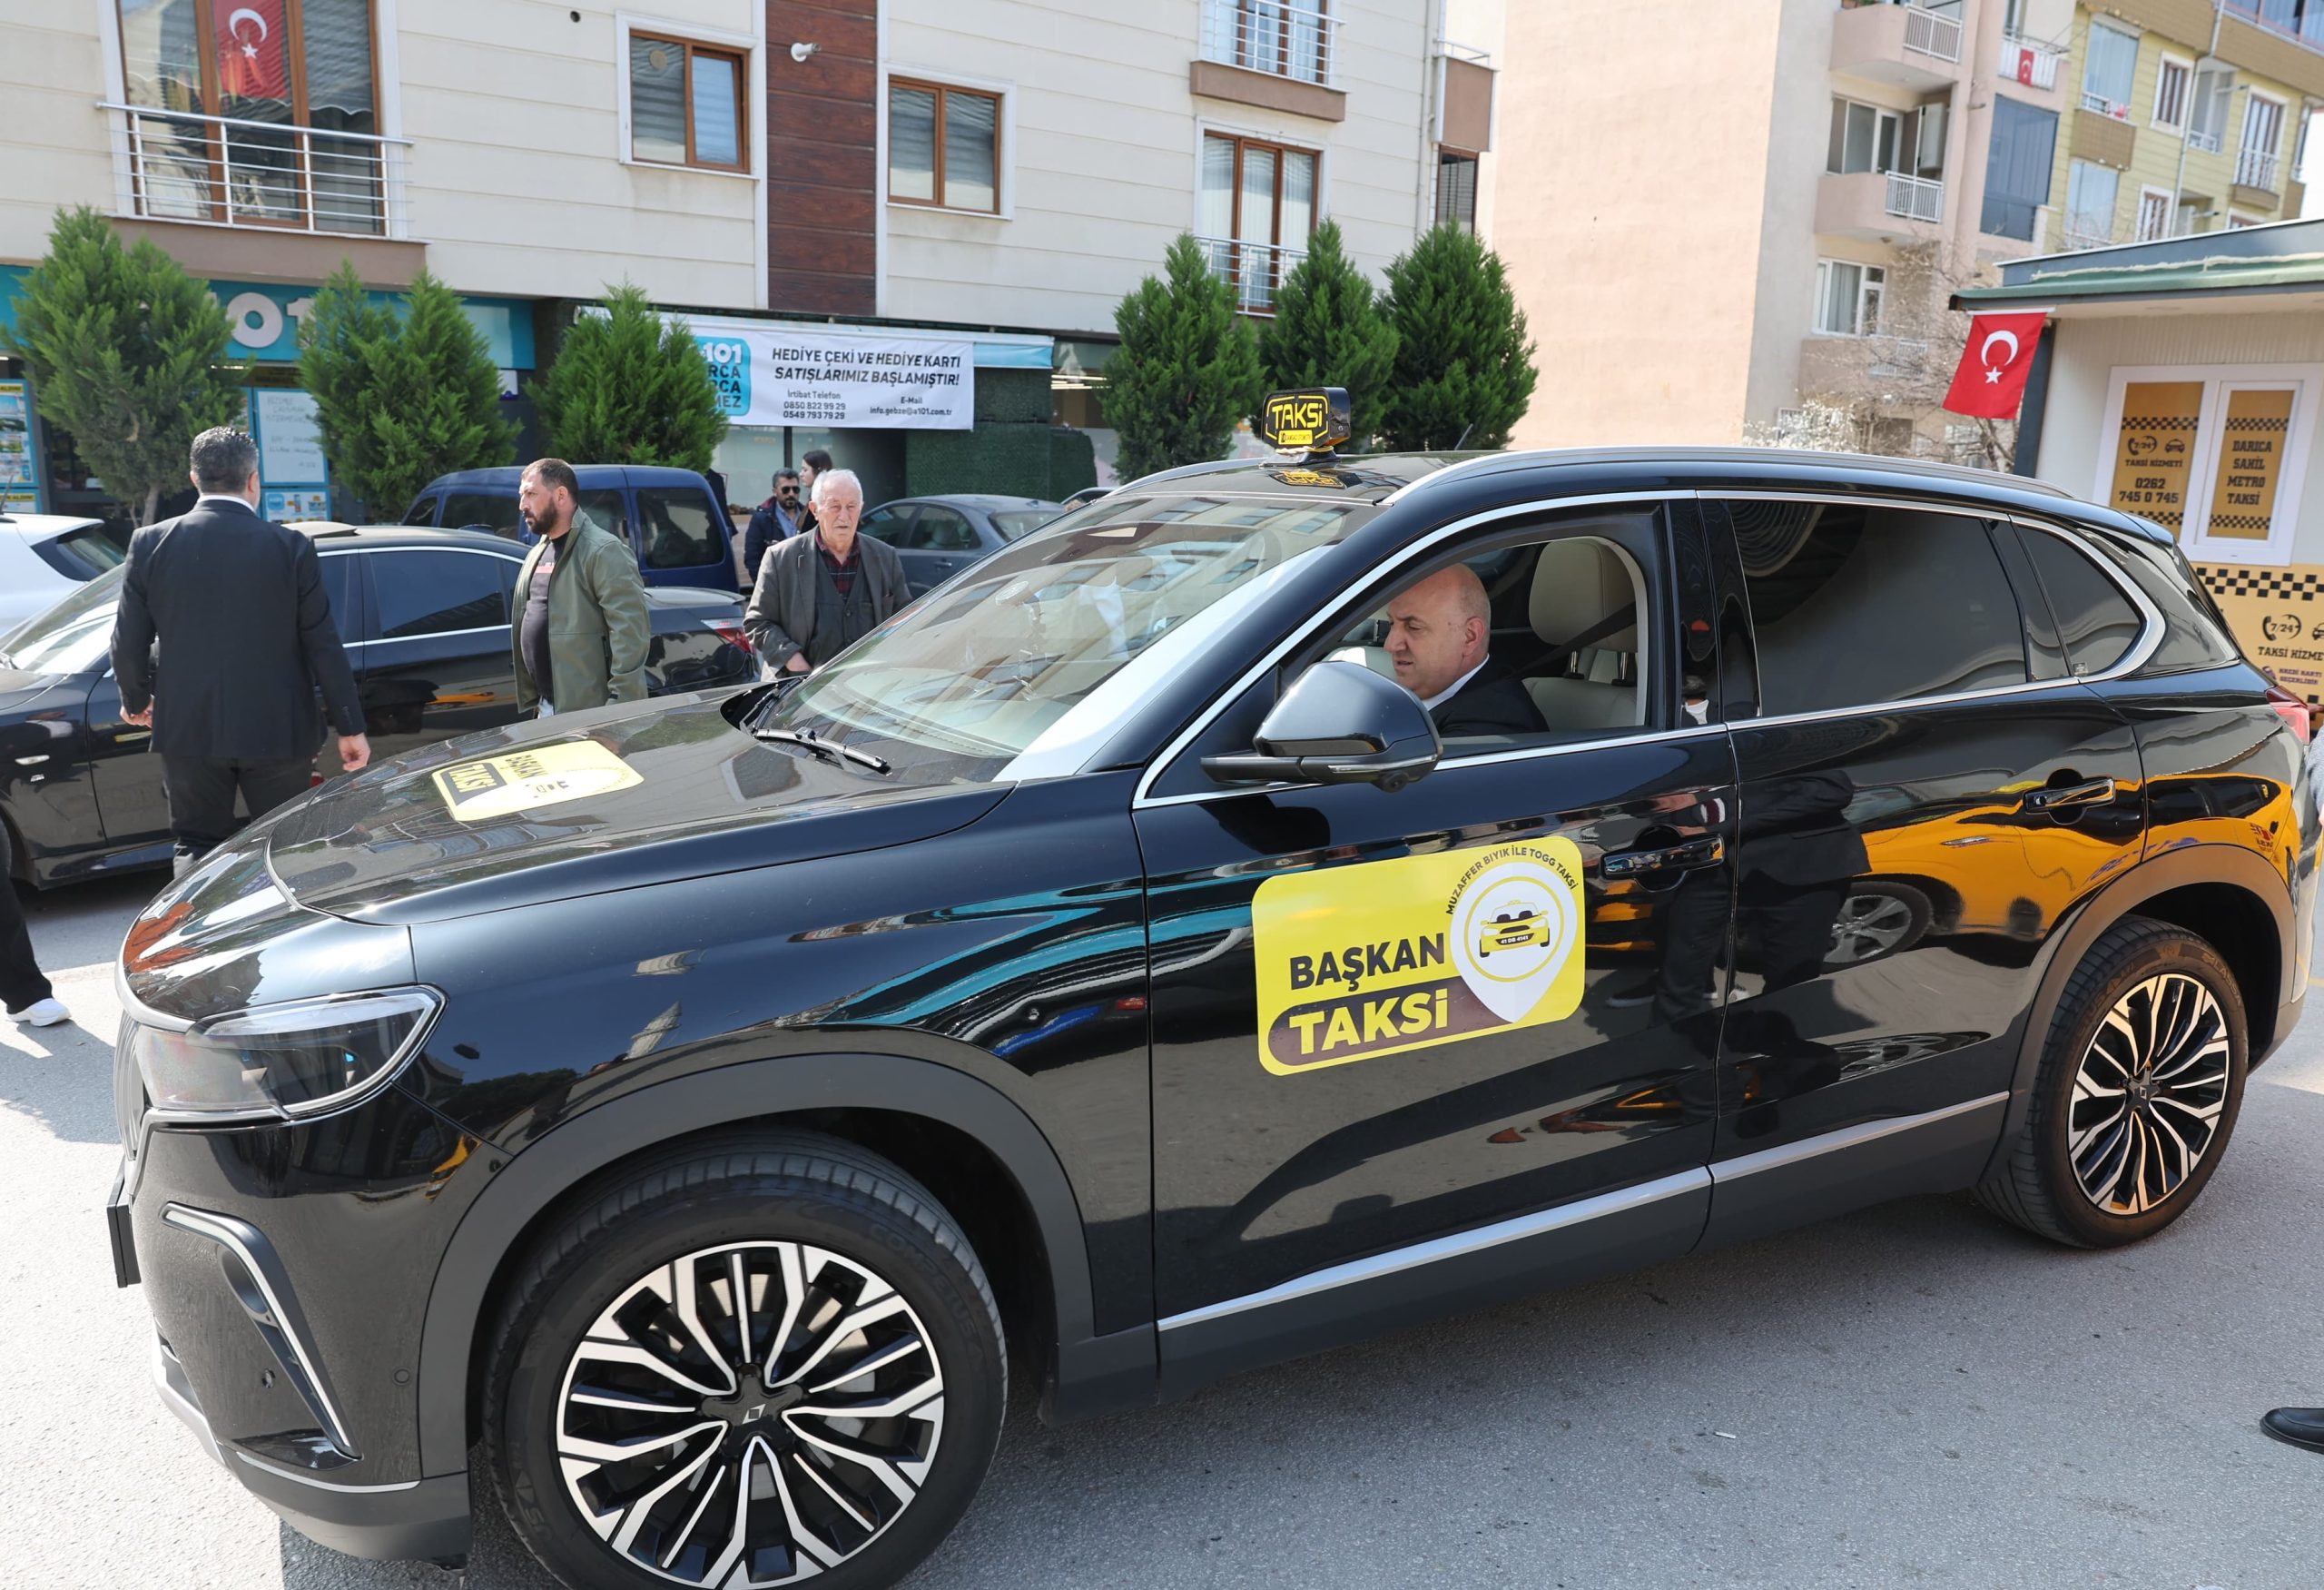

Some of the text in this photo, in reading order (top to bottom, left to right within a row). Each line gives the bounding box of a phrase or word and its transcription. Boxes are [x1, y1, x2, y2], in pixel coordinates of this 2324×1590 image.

[773, 346, 960, 368] HEDİYE ÇEKİ VE HEDİYE KARTI
[708, 365, 741, 378] RCA
[774, 367, 960, 389] SATIŞLARIMIZ BAŞLAMIŞTIR!
[812, 390, 841, 400] Telefon
[783, 401, 805, 410] 0850
[823, 402, 834, 410] 99
[783, 410, 805, 419] 0549
[834, 411, 845, 420] 29
[2231, 440, 2272, 452] DARICA
[2135, 478, 2166, 489] 0262
[2227, 475, 2266, 488] METRO
[2119, 491, 2141, 502] 745
[2156, 492, 2179, 504] 745
[2227, 491, 2260, 505] TAKSİ
[2270, 623, 2293, 633] 7/24
[2258, 646, 2324, 661] TAKSİ HİZME
[1445, 845, 1579, 915] MUZAFFER BIYIK İLE TOGG TAKSİ
[1289, 932, 1445, 993] BAŞKAN
